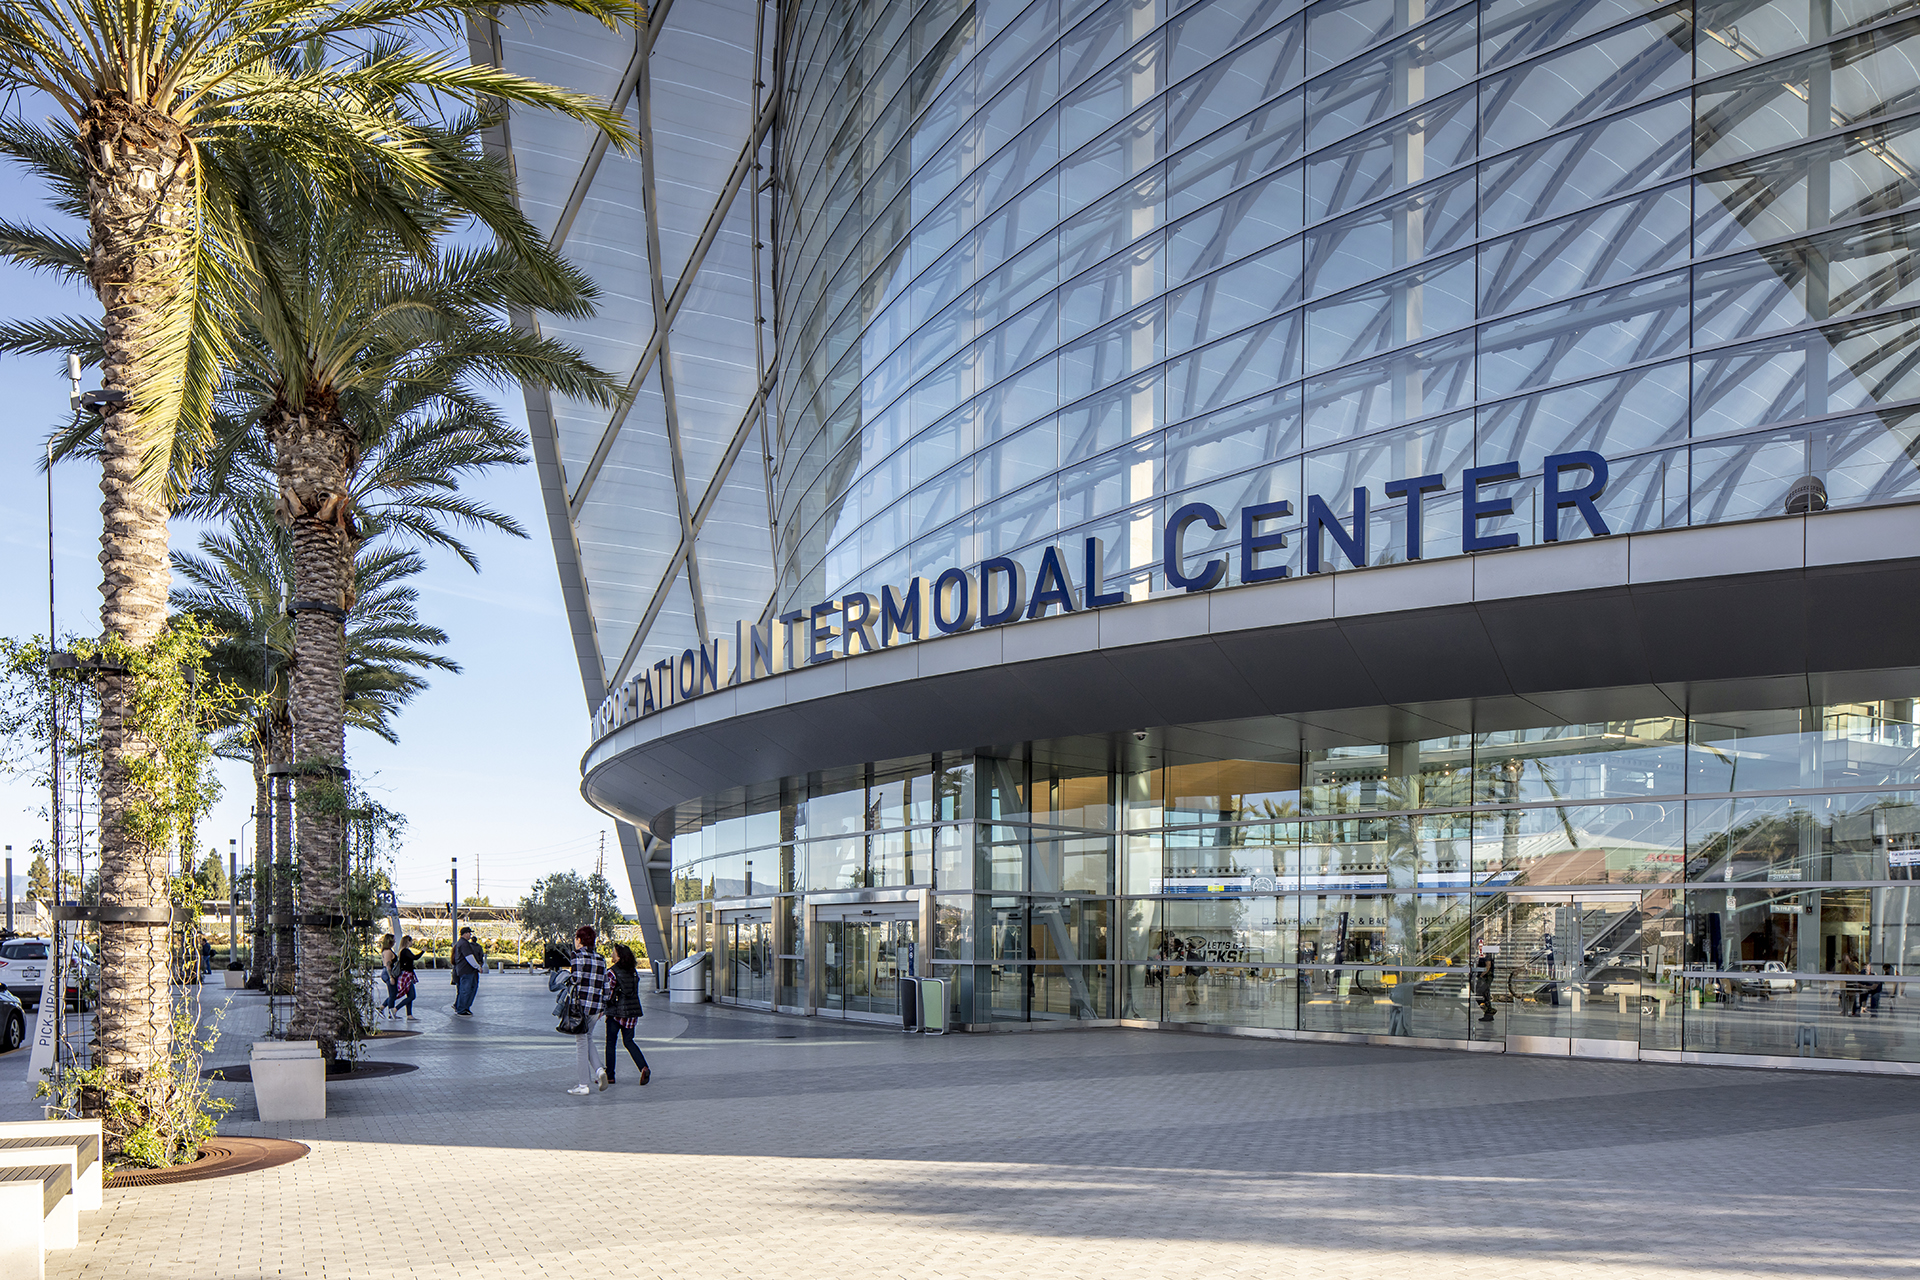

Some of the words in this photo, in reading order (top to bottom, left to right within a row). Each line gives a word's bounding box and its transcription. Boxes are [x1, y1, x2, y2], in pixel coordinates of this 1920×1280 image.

[735, 535, 1131, 683] INTERMODAL
[1164, 450, 1610, 591] CENTER
[379, 893, 393, 904] 13
[1273, 917, 1312, 925] AMTRAK
[1359, 917, 1365, 925] &
[1207, 941, 1231, 950] LET'S
